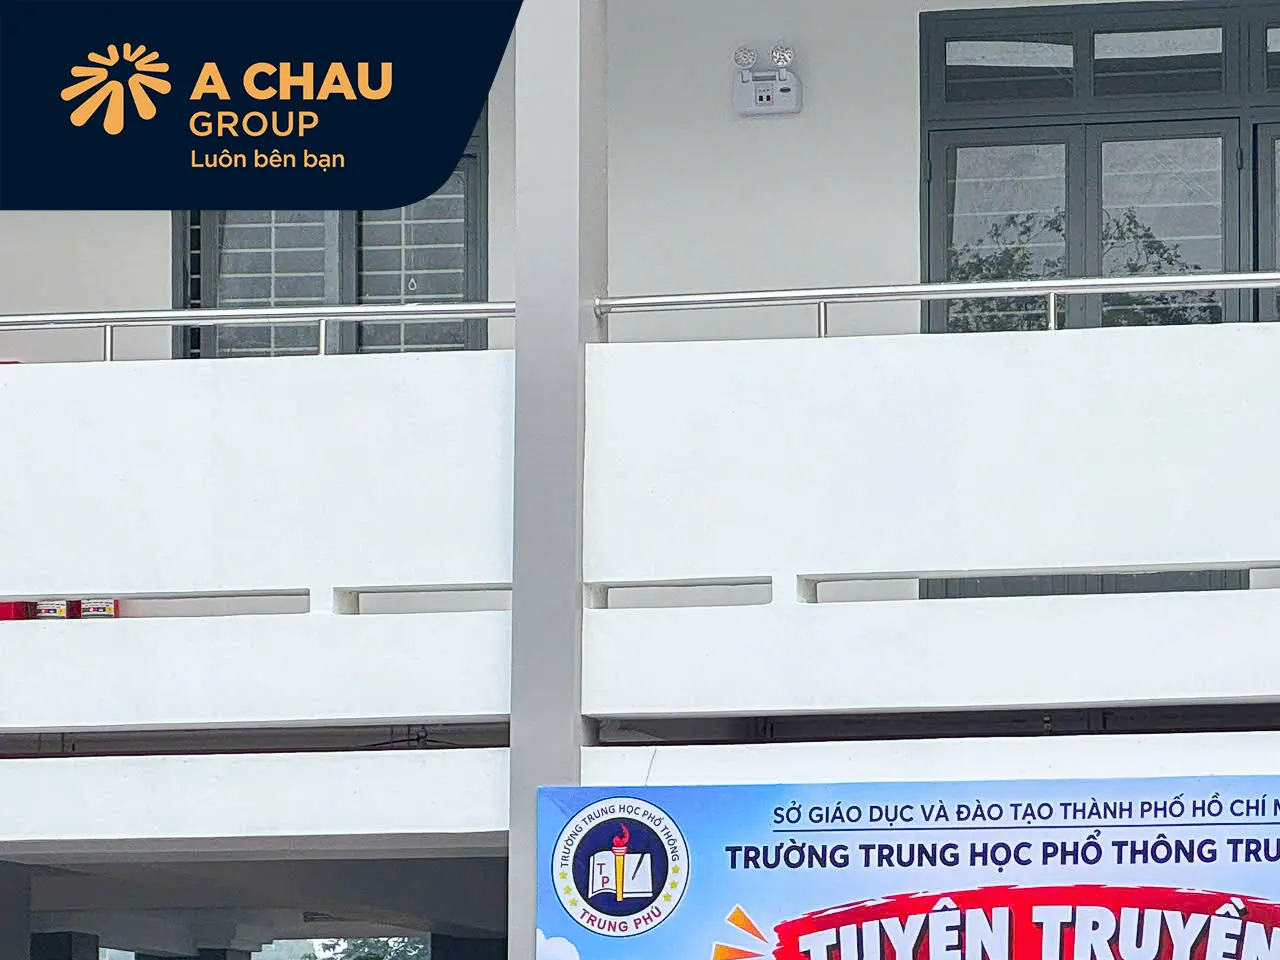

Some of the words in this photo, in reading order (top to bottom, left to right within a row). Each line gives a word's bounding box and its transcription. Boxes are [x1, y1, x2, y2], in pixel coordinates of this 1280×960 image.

[773, 800, 802, 824] SỞ
[808, 800, 862, 824] GIÁO
[869, 804, 914, 827] DỤC
[921, 799, 950, 822] VÀ
[955, 799, 1003, 822] ĐÀO
[1009, 803, 1054, 827] TẠO
[1060, 795, 1133, 819] THÀNH
[1140, 793, 1185, 818] PHỐ
[1191, 793, 1223, 817] HỒ
[1231, 793, 1266, 817] CHÍ
[560, 825, 584, 868] TRƯỜNG
[581, 805, 616, 825] TRUNG
[618, 804, 640, 816] HỌC
[642, 809, 665, 828] PHỔ
[660, 824, 680, 863] THÔNG
[725, 839, 850, 869] TRƯỜNG
[859, 843, 960, 868] TRUNG
[970, 841, 1032, 873] HỌC
[1042, 829, 1103, 865] PHỔ
[1112, 833, 1217, 864] THÔNG
[579, 907, 628, 932] TRUNG
[633, 904, 662, 929] PHÚ
